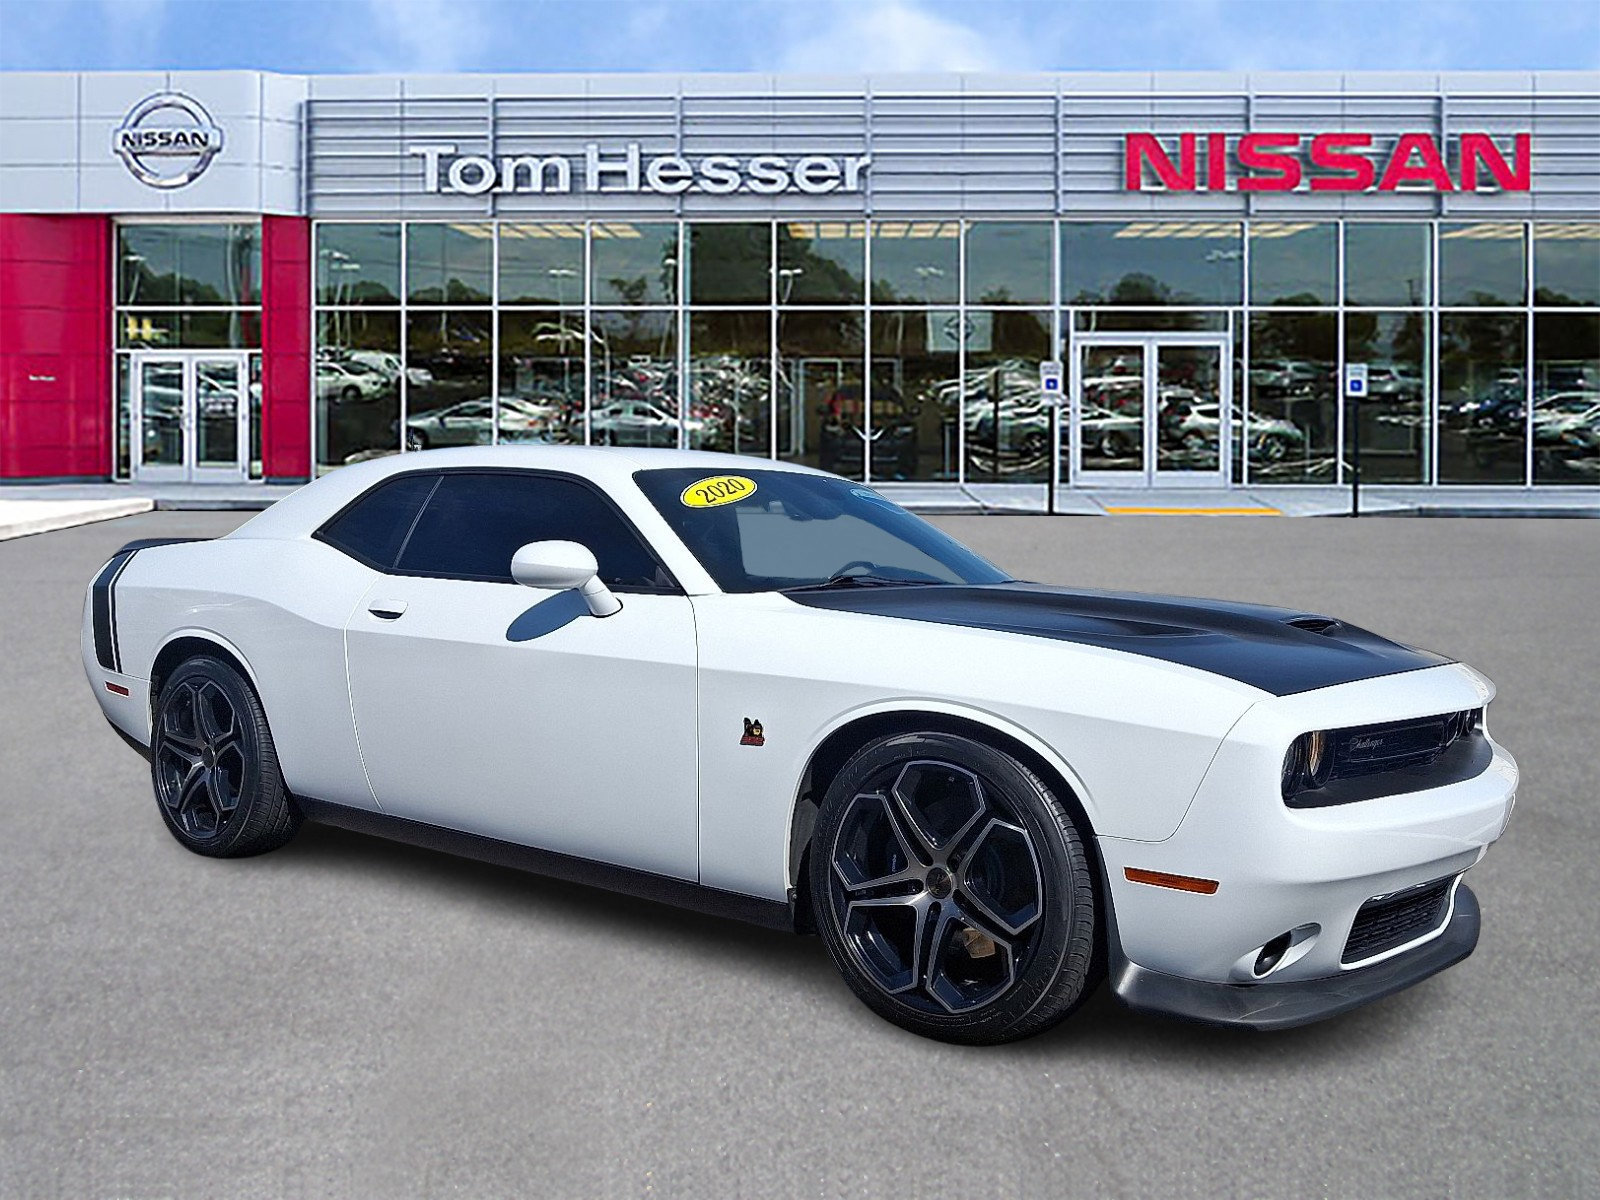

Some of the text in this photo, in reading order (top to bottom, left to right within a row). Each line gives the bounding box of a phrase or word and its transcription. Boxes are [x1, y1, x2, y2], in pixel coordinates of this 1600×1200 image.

[122, 131, 209, 147] NISSAN
[409, 143, 871, 194] Tom Hesser
[1125, 132, 1531, 191] NISSAN
[695, 479, 746, 503] 2020
